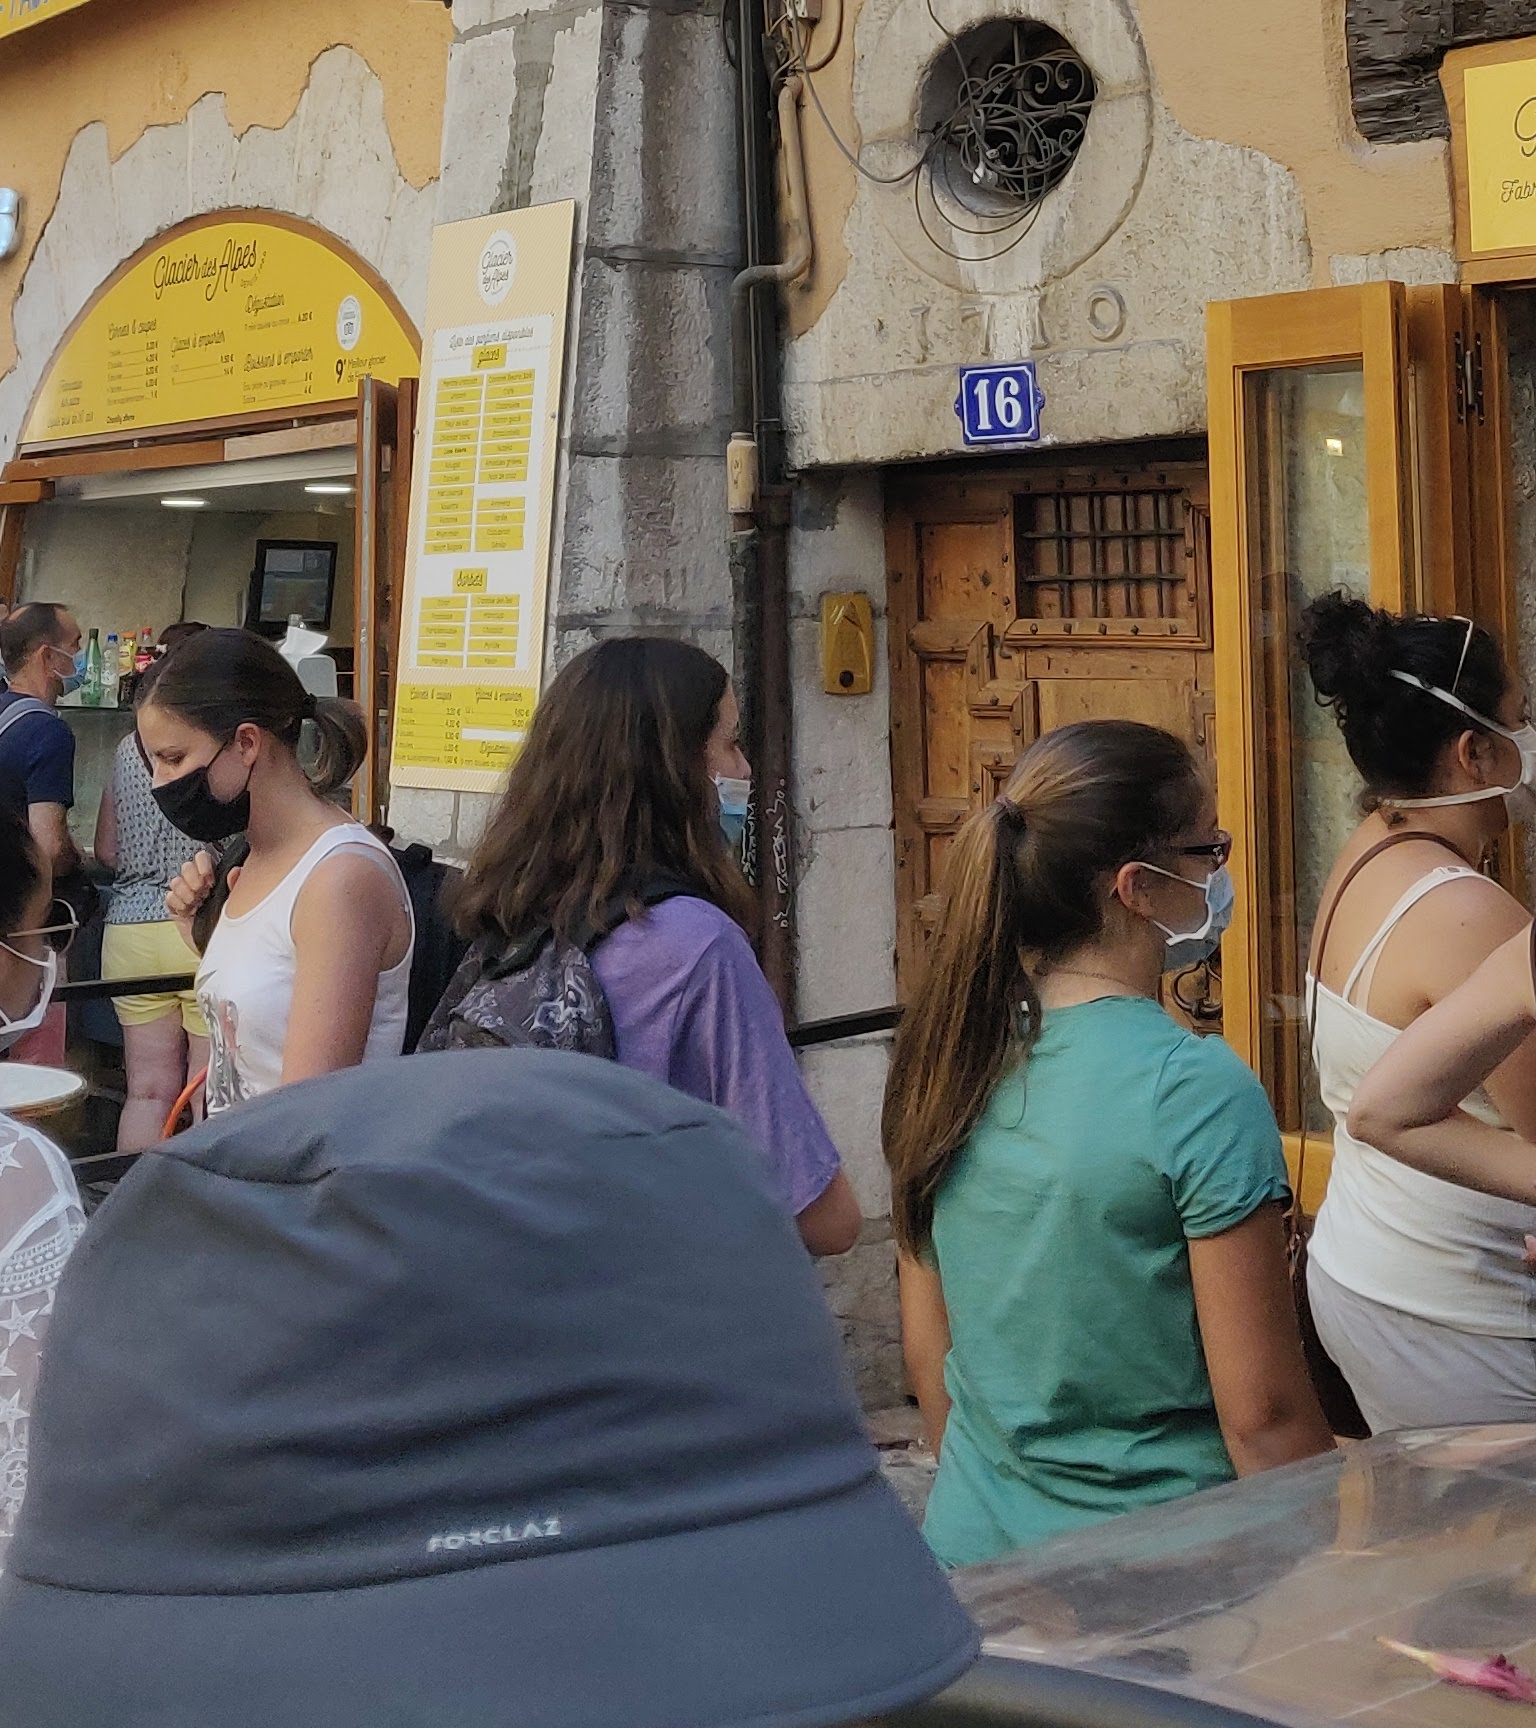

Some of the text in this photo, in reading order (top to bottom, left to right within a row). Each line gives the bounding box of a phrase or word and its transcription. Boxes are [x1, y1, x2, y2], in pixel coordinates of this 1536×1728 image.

[154, 253, 201, 300] Glacier
[205, 238, 257, 301] Alpes
[481, 249, 513, 275] Glacier
[973, 376, 1022, 431] 16
[426, 1515, 562, 1553] FORCLAZ
